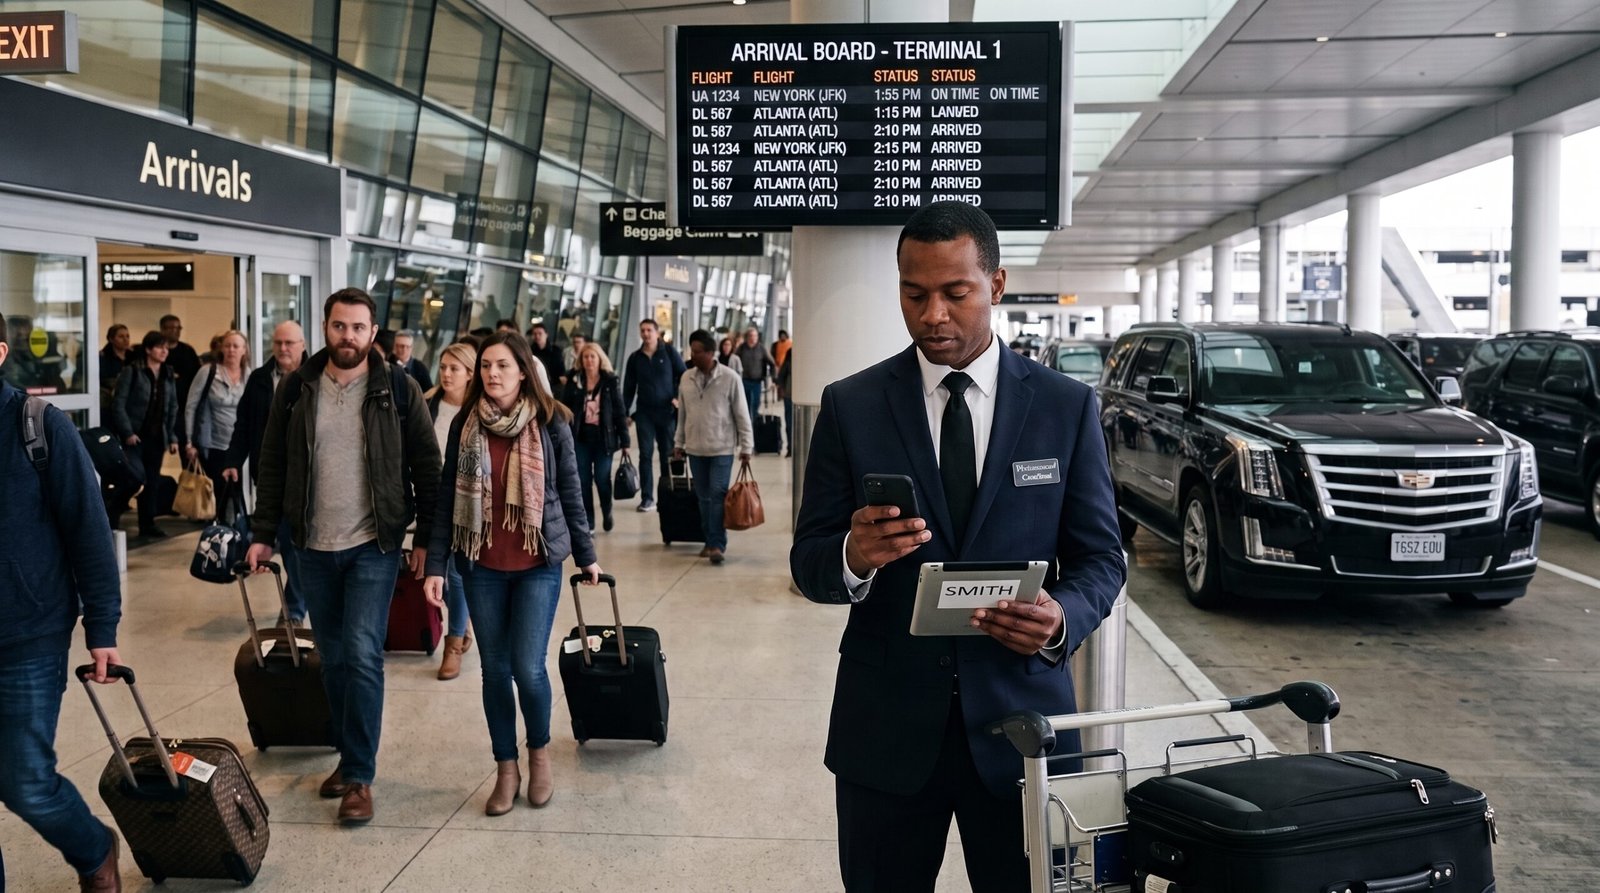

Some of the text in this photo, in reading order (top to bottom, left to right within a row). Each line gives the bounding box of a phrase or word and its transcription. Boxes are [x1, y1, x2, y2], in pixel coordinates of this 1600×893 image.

[0, 24, 54, 60] EXIT
[731, 42, 808, 61] ARRIVAL
[813, 41, 876, 60] BOARD
[893, 40, 988, 60] TERMINAL
[992, 39, 1001, 59] 1
[691, 68, 976, 84] FLIGHT FLIGHT STATUS STATUS
[692, 87, 1040, 102] UA 1234 NEW YORK (JFK) 1:55 PM ON TIME ON TIME
[692, 107, 709, 119] DL
[711, 107, 733, 119] 567
[753, 106, 806, 119] ATLANTA
[808, 106, 839, 120] (ATL)
[874, 106, 900, 118] 1:15
[902, 106, 921, 118] PM
[692, 125, 709, 137] DL
[753, 124, 806, 137] ATLANTA
[808, 124, 839, 138] (ATL)
[874, 124, 900, 136] 2:10
[902, 124, 921, 136] PM
[930, 123, 982, 136] ARRIVED
[692, 141, 982, 156] UA 1234 NEW YORK (JFK) 2:15 PM ARRIVED
[139, 141, 252, 203] Arrivals
[692, 158, 982, 173] DL 567 ATLANTA (ATL) 2:10 PM ARRIVED
[692, 176, 982, 191] DL 567 ATLANTA (ATL) 2:10 PM ARRIVED
[692, 196, 709, 208] DL
[711, 196, 733, 208] 567
[753, 195, 806, 208] ATLANTA
[808, 195, 839, 209] (ATL)
[874, 195, 900, 207] 2:10
[902, 195, 921, 207] PM
[945, 585, 1013, 596] SMITH
